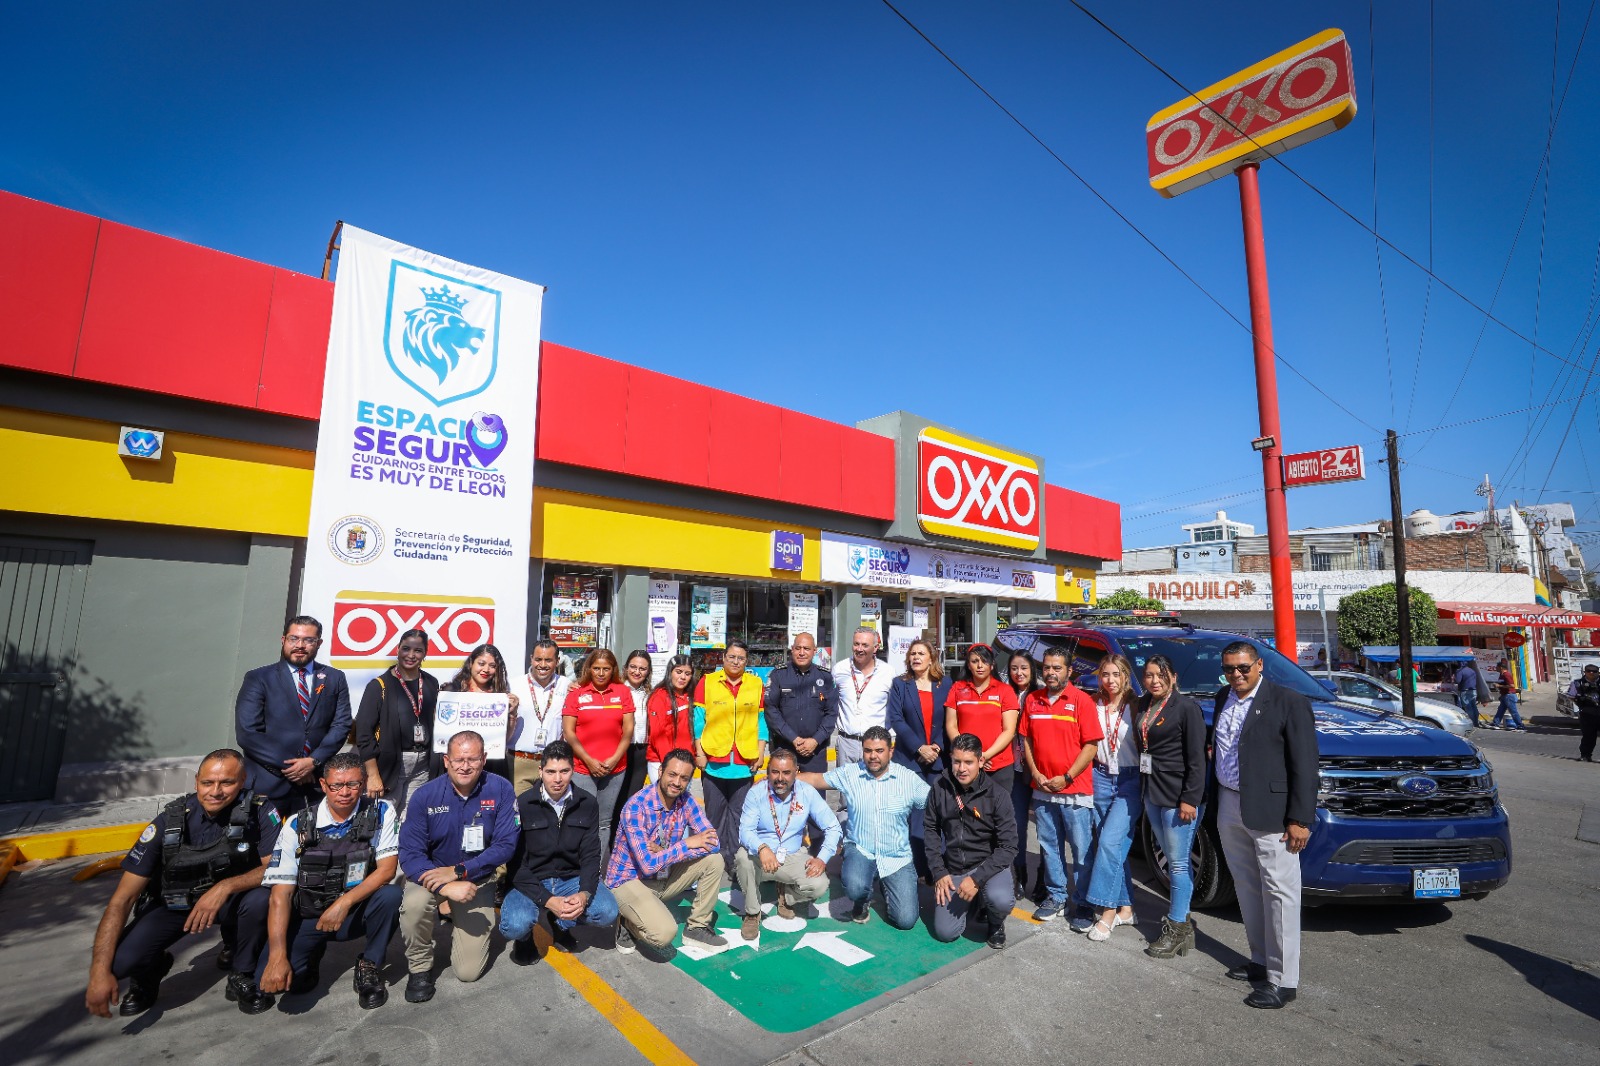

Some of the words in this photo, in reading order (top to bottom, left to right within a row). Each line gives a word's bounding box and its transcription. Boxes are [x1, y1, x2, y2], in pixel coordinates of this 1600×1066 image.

[1154, 56, 1338, 166] OXXO
[352, 452, 426, 472] CUIDARNOS
[428, 464, 465, 478] ENTRE
[1288, 458, 1319, 479] ABIERTO
[1322, 450, 1356, 470] 24
[350, 464, 374, 480] ES
[379, 467, 425, 487] MUY
[429, 475, 454, 492] DE
[458, 479, 506, 499] LEÓN
[1323, 468, 1357, 478] HORAS
[927, 455, 1036, 527] OXXO
[395, 527, 446, 542] Secretaría
[448, 534, 461, 543] de
[393, 548, 448, 562] Ciudadana
[394, 538, 452, 551] Prevención
[454, 545, 460, 554] y
[462, 544, 513, 557] Protección
[776, 541, 802, 556] spin
[1148, 580, 1240, 602] MAQUILA
[1460, 612, 1485, 623] Mini
[1487, 614, 1520, 625] Super
[337, 607, 490, 655] OXXO
